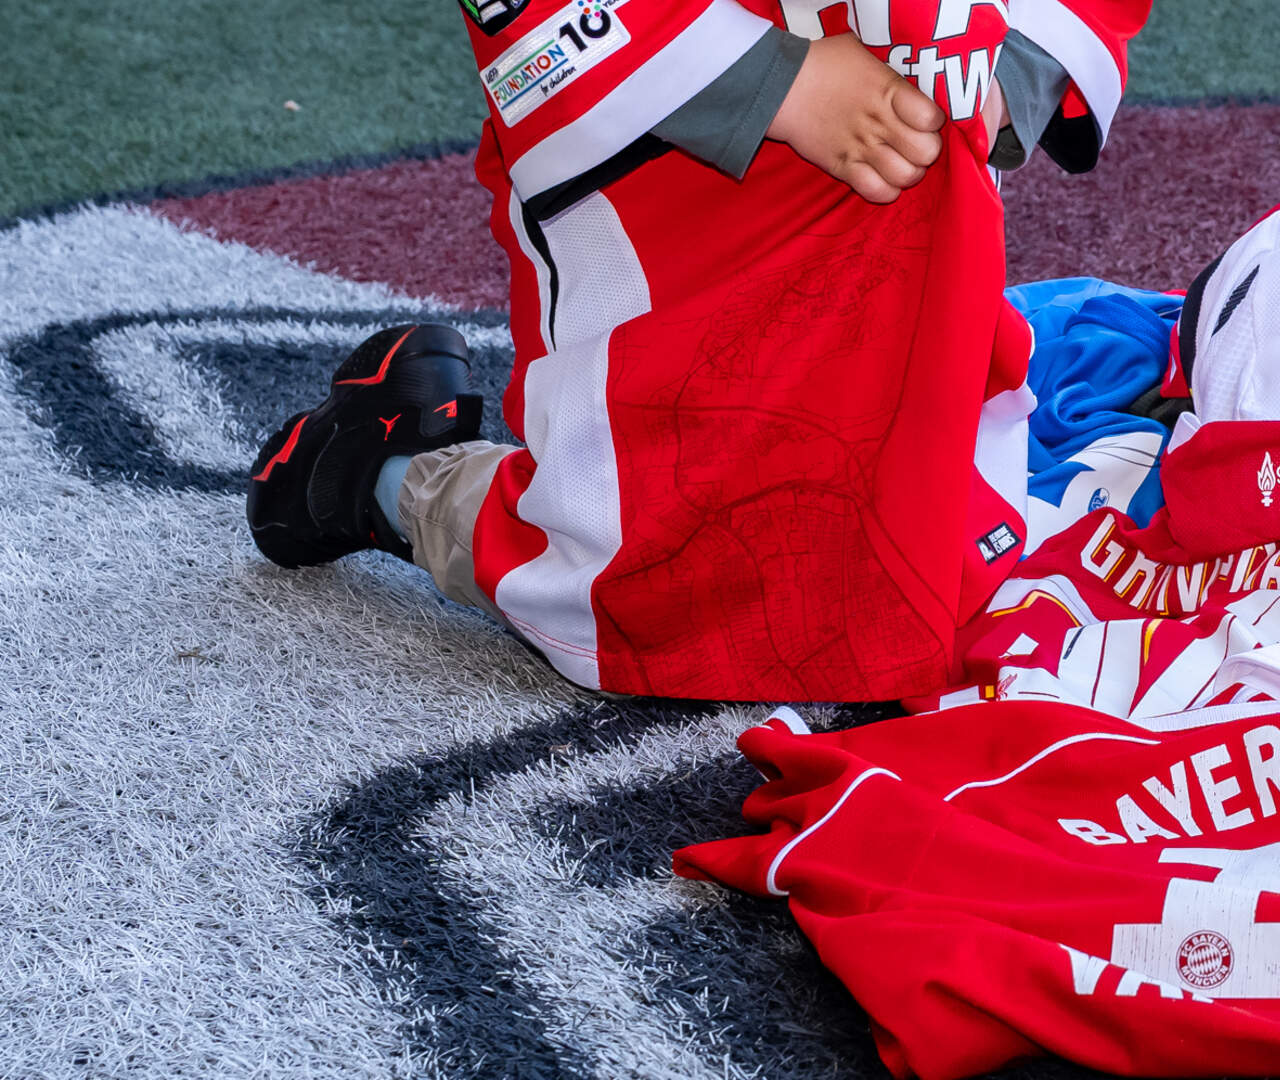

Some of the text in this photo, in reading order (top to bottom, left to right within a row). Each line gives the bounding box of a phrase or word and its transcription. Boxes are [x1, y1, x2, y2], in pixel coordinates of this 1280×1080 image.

[559, 9, 611, 53] 10
[492, 44, 566, 105] FOUNDATION
[1181, 935, 1229, 957] FC BAYERN
